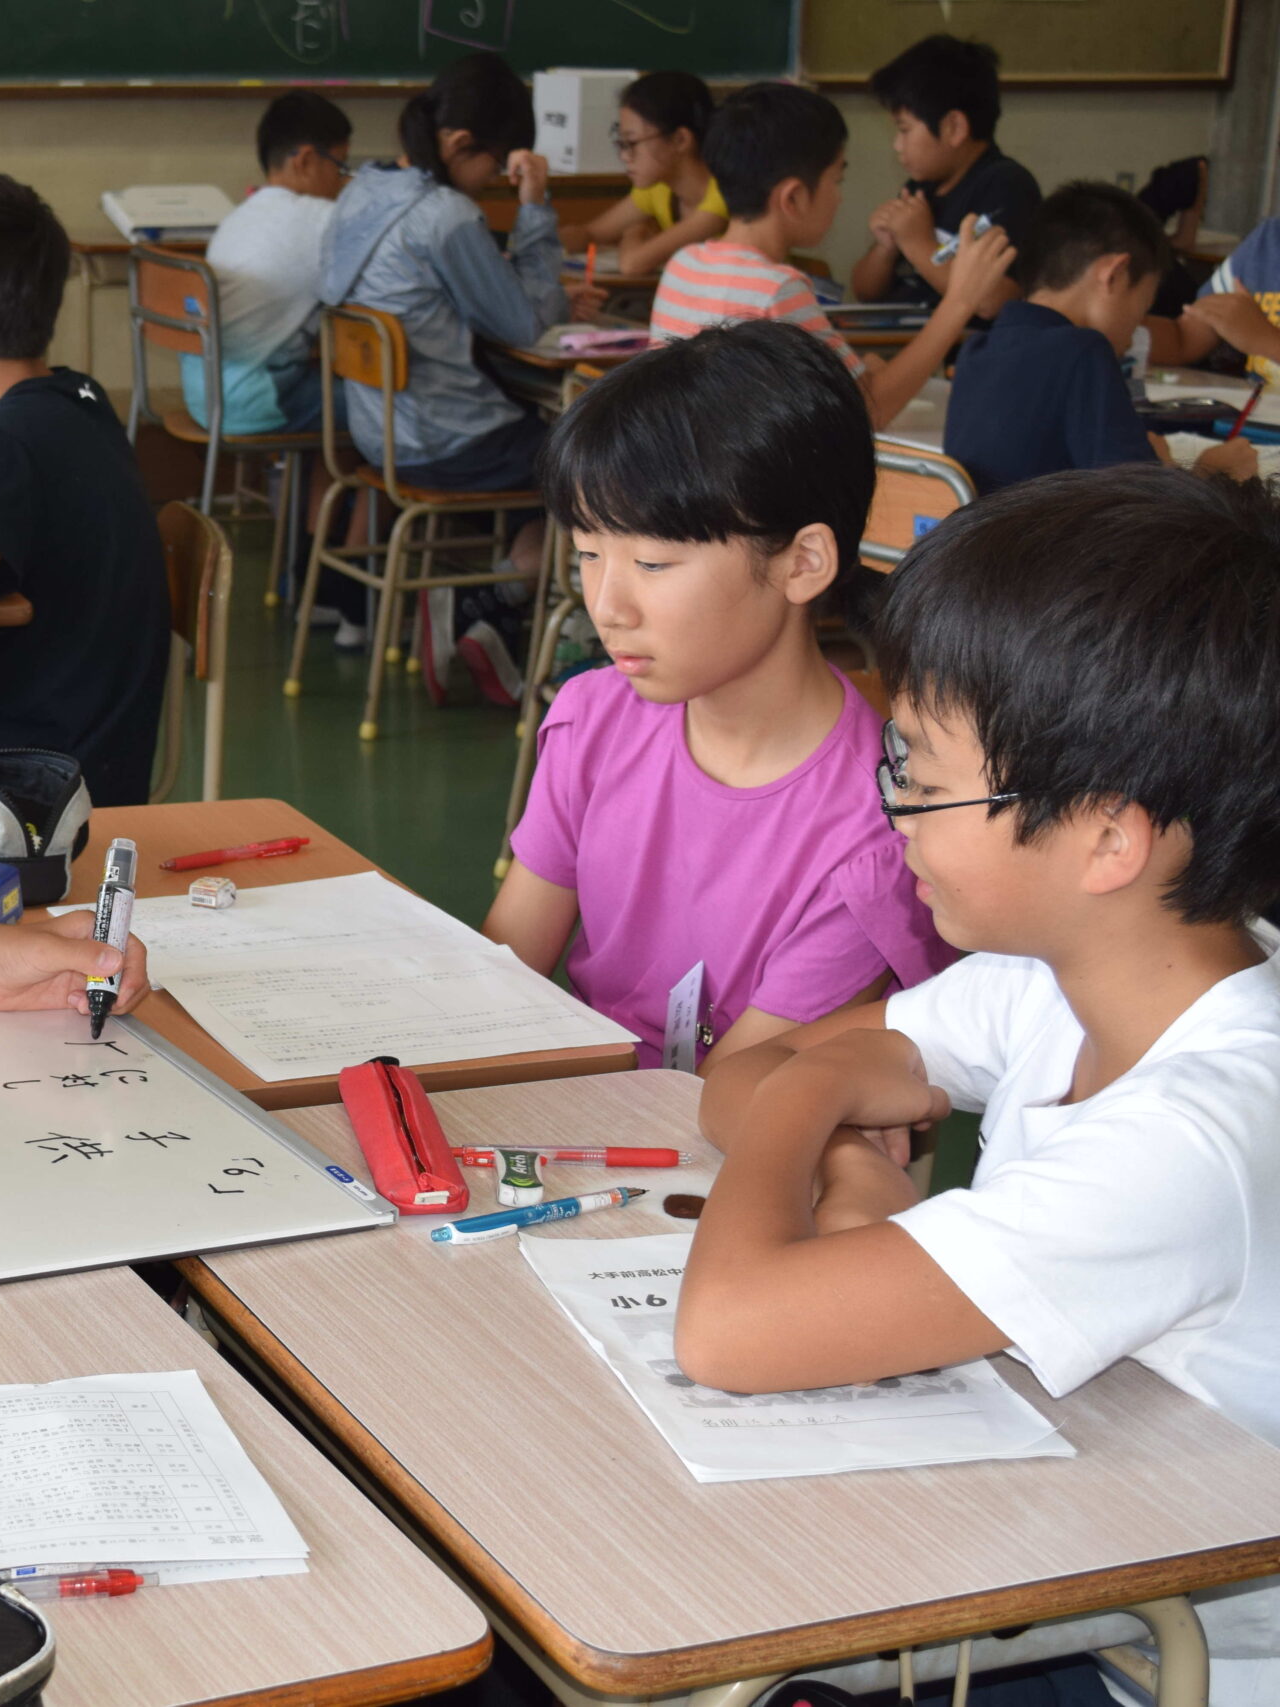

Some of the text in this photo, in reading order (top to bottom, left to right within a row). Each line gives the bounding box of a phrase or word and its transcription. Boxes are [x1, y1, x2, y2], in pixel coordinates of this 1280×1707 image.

[509, 1154, 528, 1175] Arch
[587, 1267, 687, 1280] 大手前高松中
